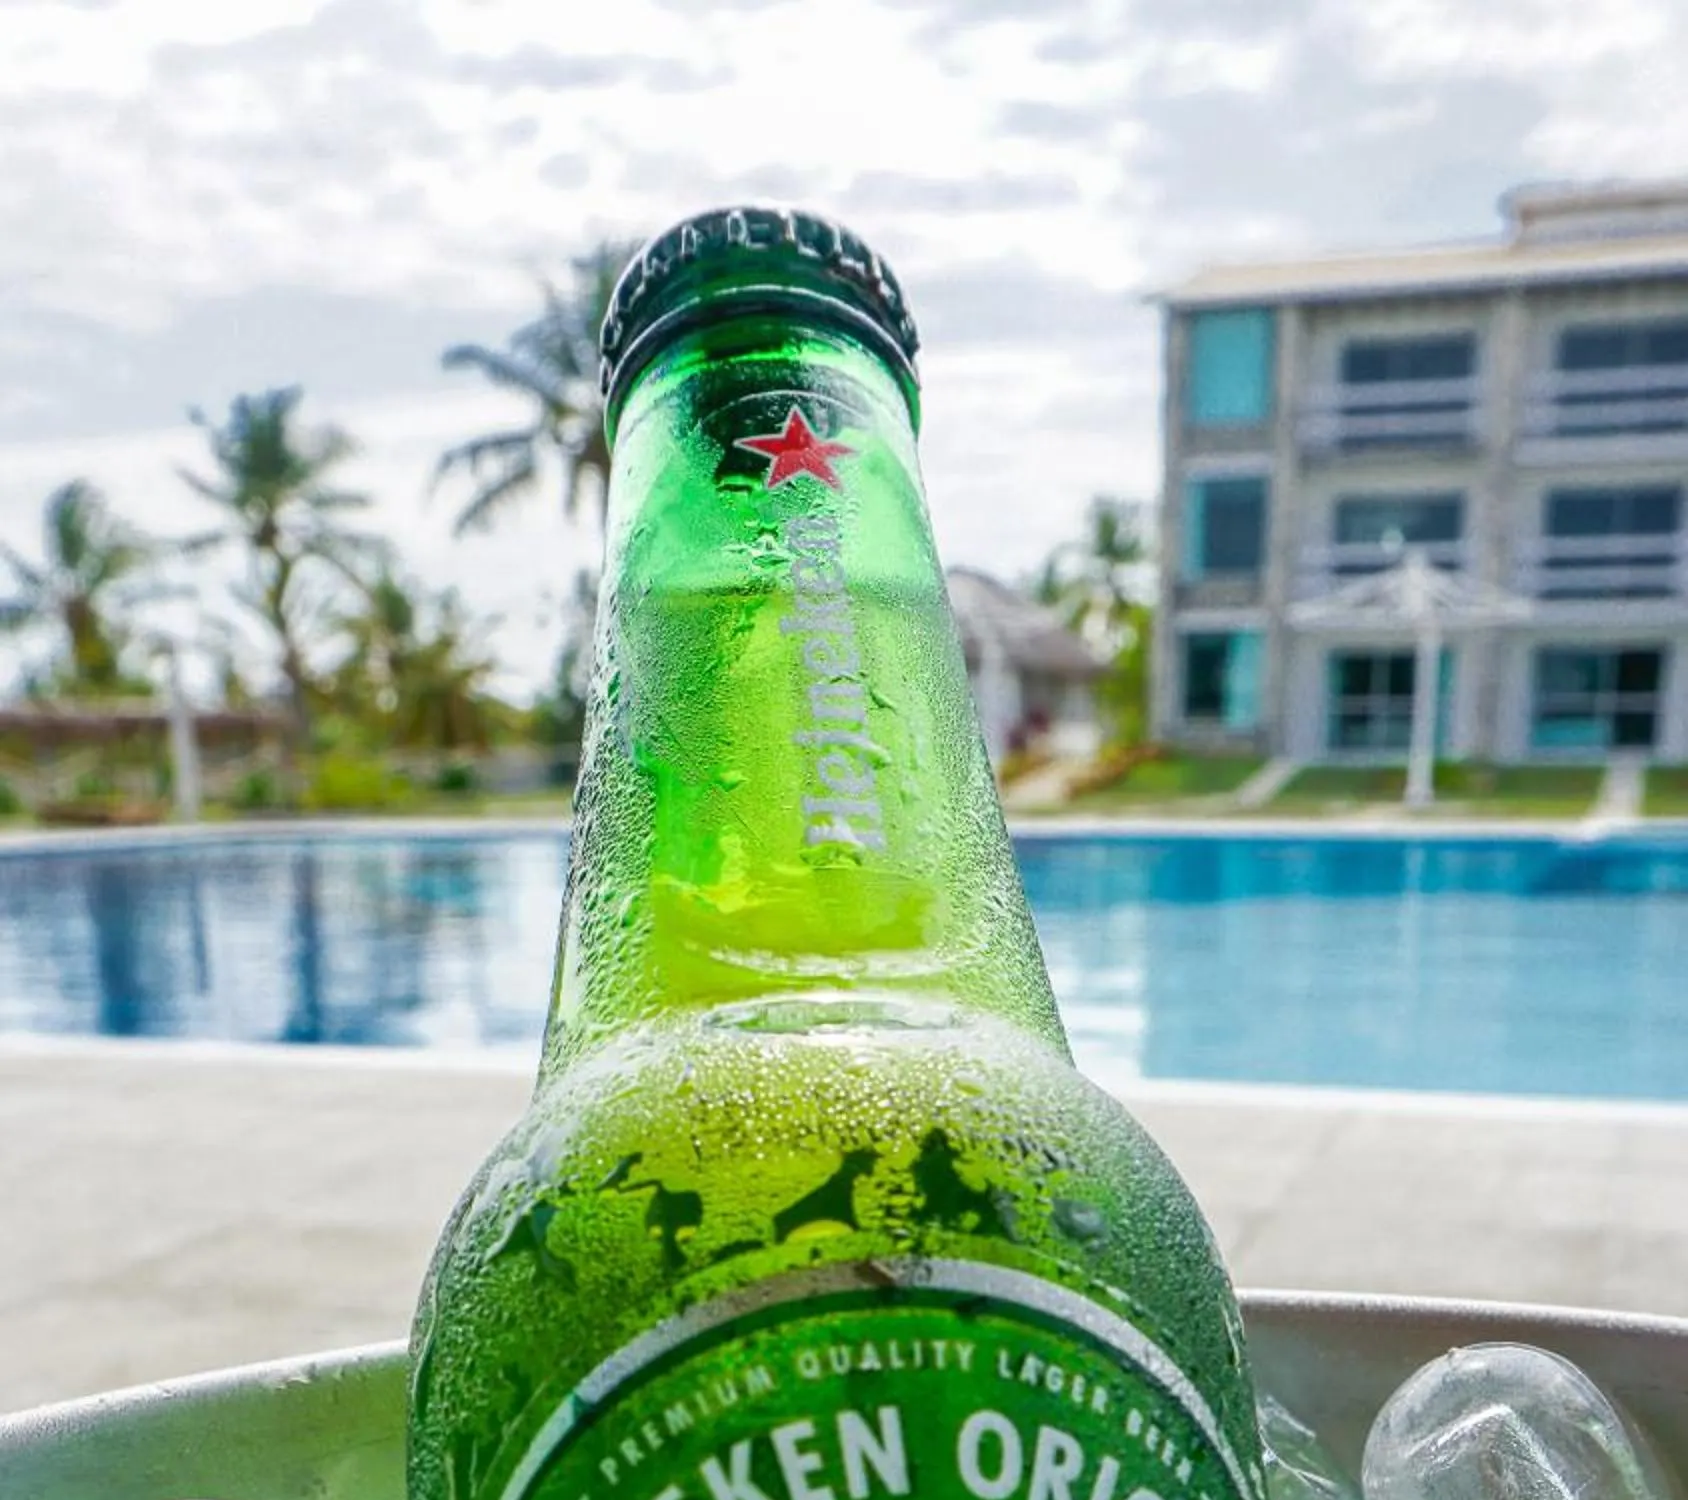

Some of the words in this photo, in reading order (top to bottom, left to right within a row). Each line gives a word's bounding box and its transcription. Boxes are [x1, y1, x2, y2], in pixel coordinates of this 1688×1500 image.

[780, 514, 886, 851] Heineken
[600, 1363, 775, 1485] PREMIUM
[800, 1339, 975, 1379] QUALITY
[999, 1349, 1108, 1416] LAGER
[1125, 1407, 1194, 1487] BEER
